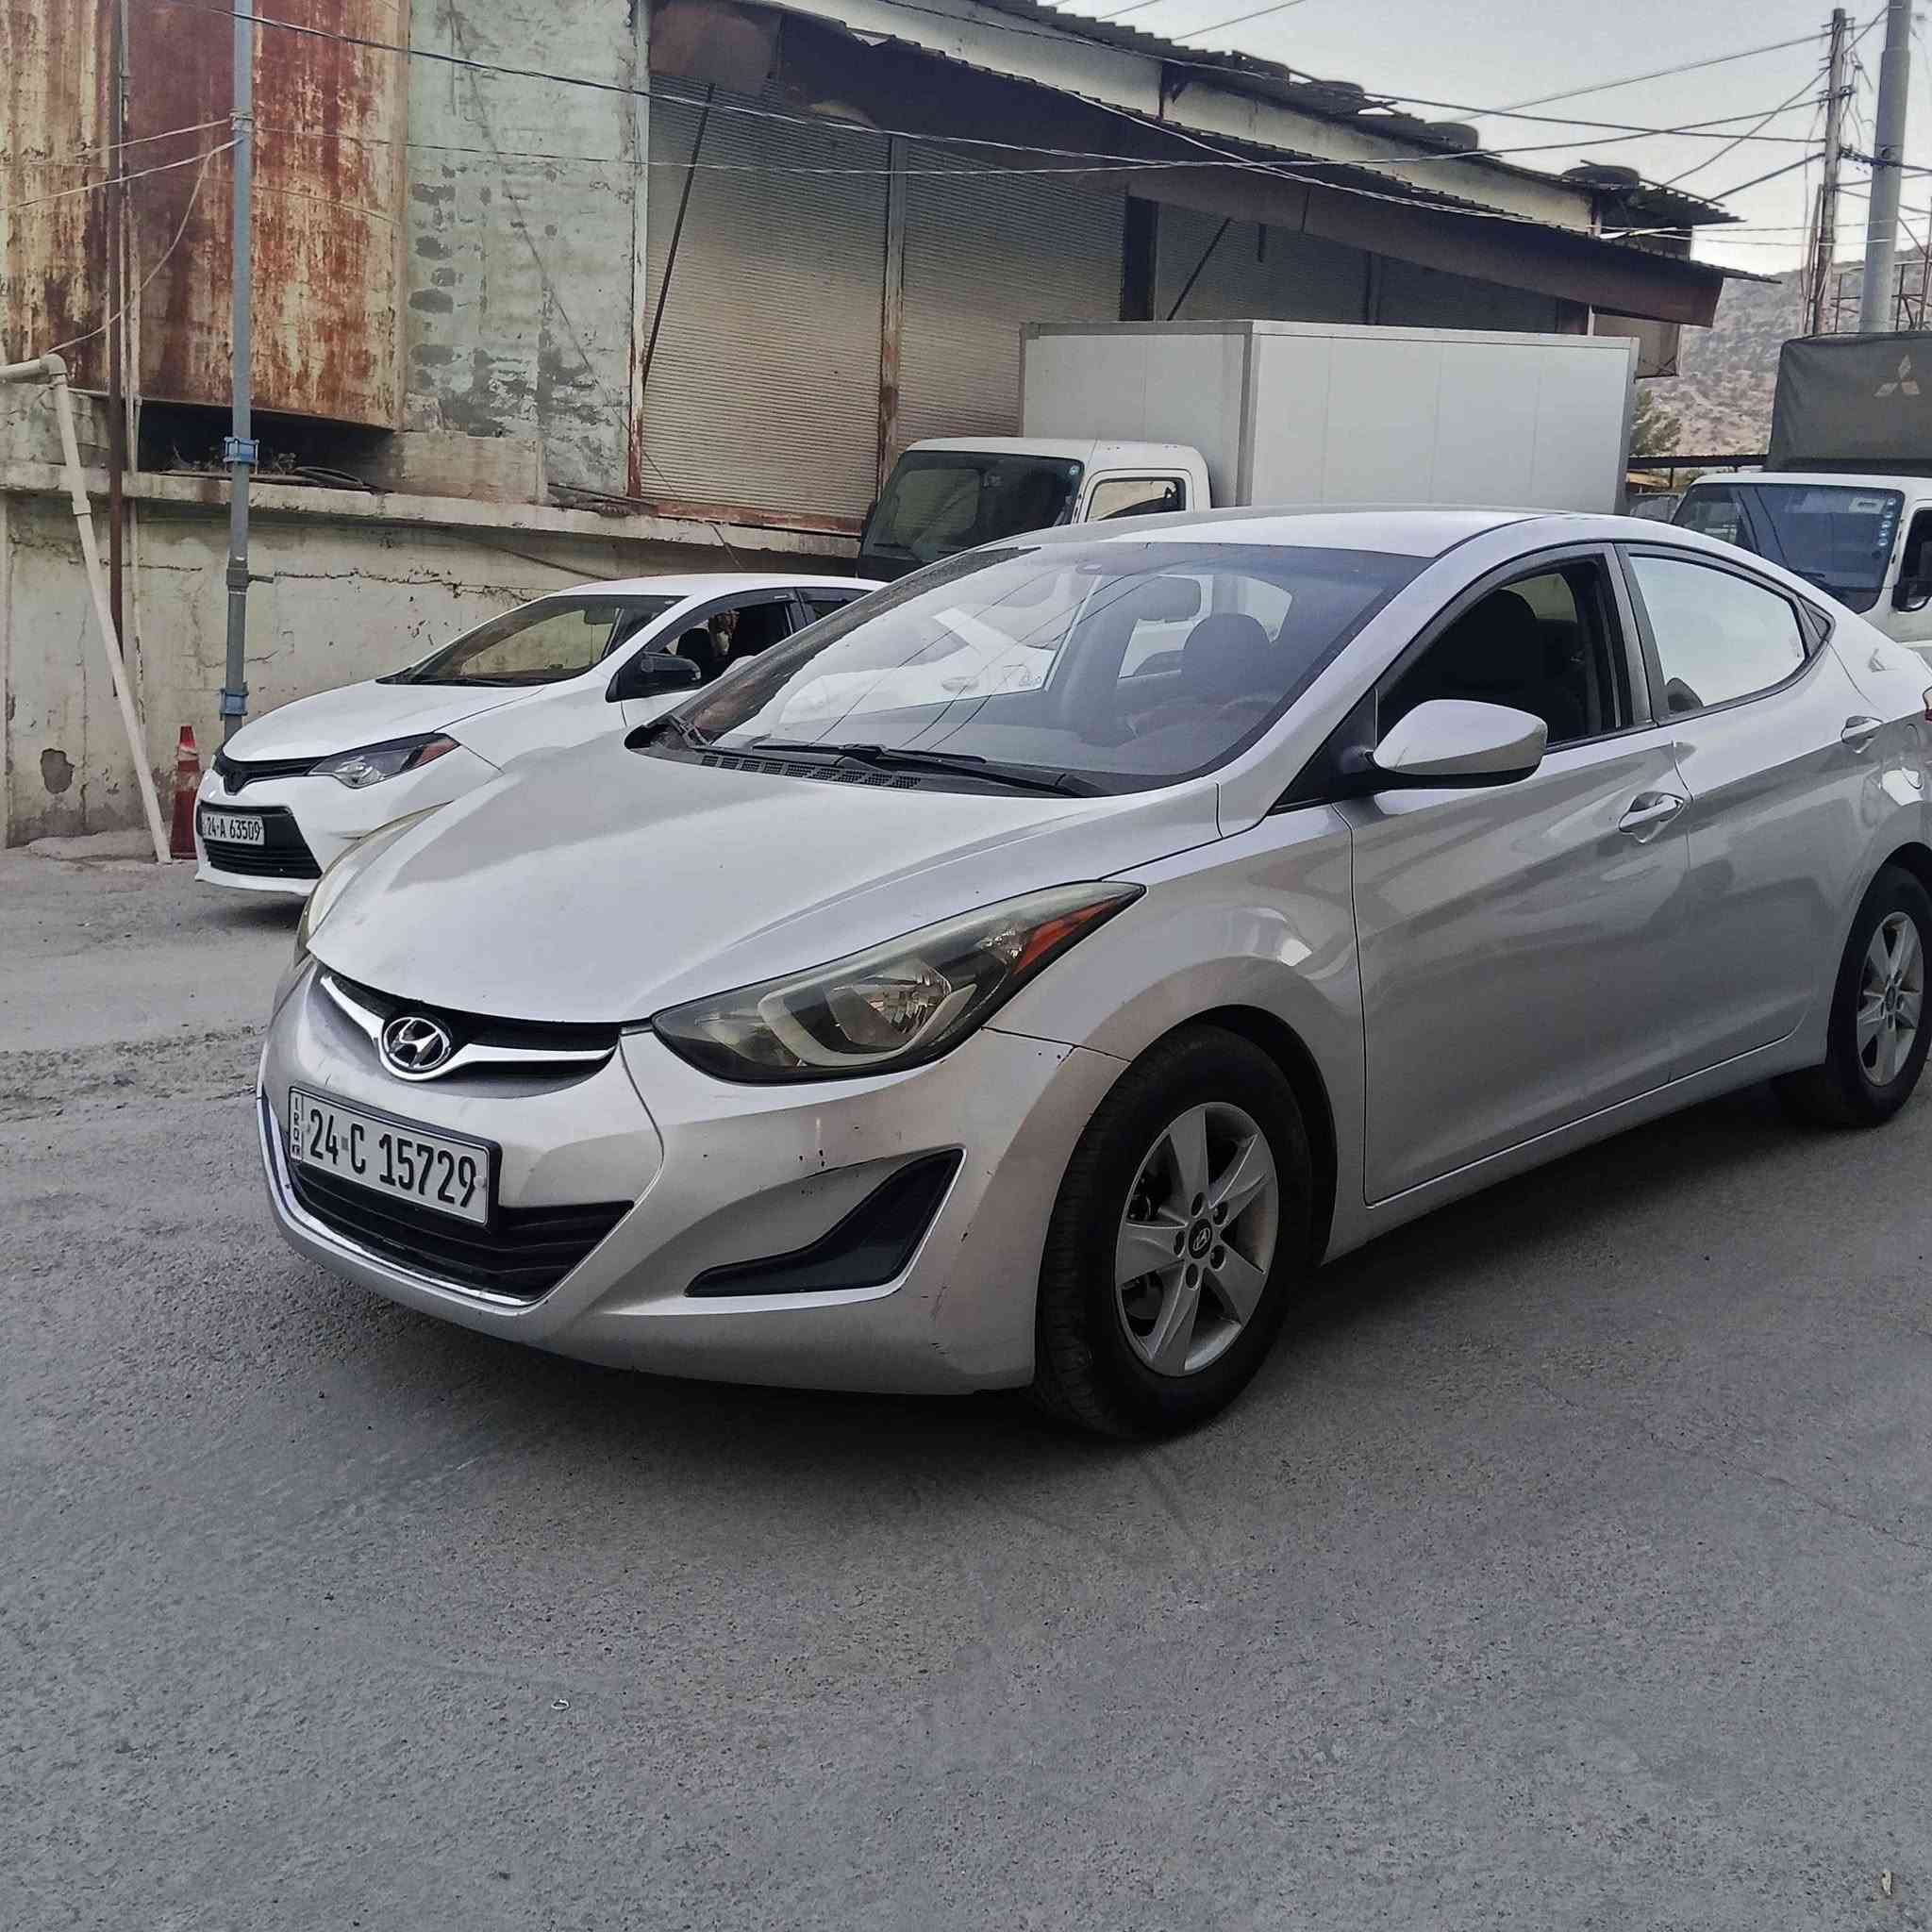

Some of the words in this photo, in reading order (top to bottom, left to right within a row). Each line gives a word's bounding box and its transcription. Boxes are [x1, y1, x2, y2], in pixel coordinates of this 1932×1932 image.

[229, 819, 261, 841] 63509
[310, 1108, 338, 1165] 24
[350, 1123, 367, 1174] C
[379, 1133, 477, 1208] 15729
